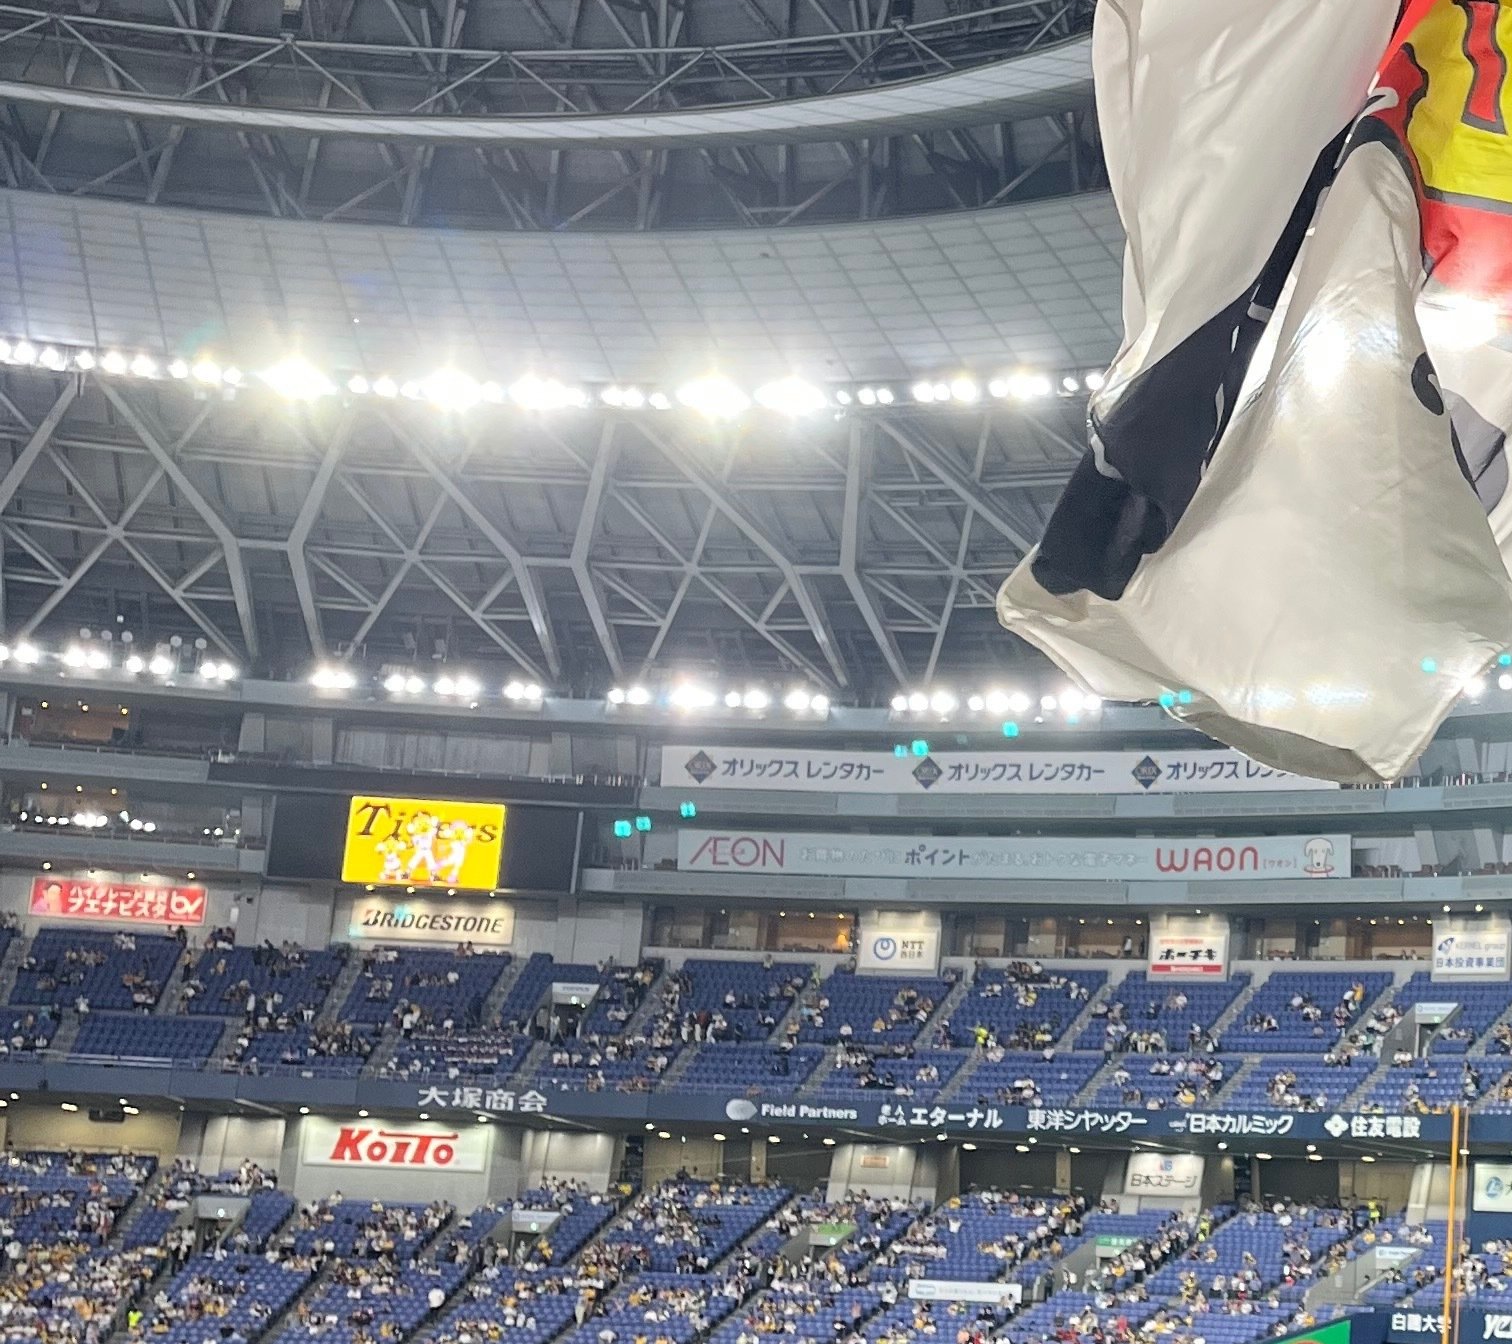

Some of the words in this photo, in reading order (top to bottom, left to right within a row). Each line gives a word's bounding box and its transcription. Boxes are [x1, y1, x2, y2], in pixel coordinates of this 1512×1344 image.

[722, 758, 799, 779] オリックス
[807, 760, 885, 781] レンタカー
[947, 761, 1023, 783] オリックス
[1028, 762, 1105, 782] レンタカー
[1166, 760, 1240, 781] オリックス
[904, 844, 970, 867] ポイント
[363, 908, 505, 934] BRIDGESTONE
[417, 1085, 548, 1113] 大塚商会
[761, 1103, 796, 1118] Field
[799, 1104, 858, 1121] Partners
[909, 1106, 1003, 1129] エターナル
[1349, 1114, 1422, 1139] 住友電設
